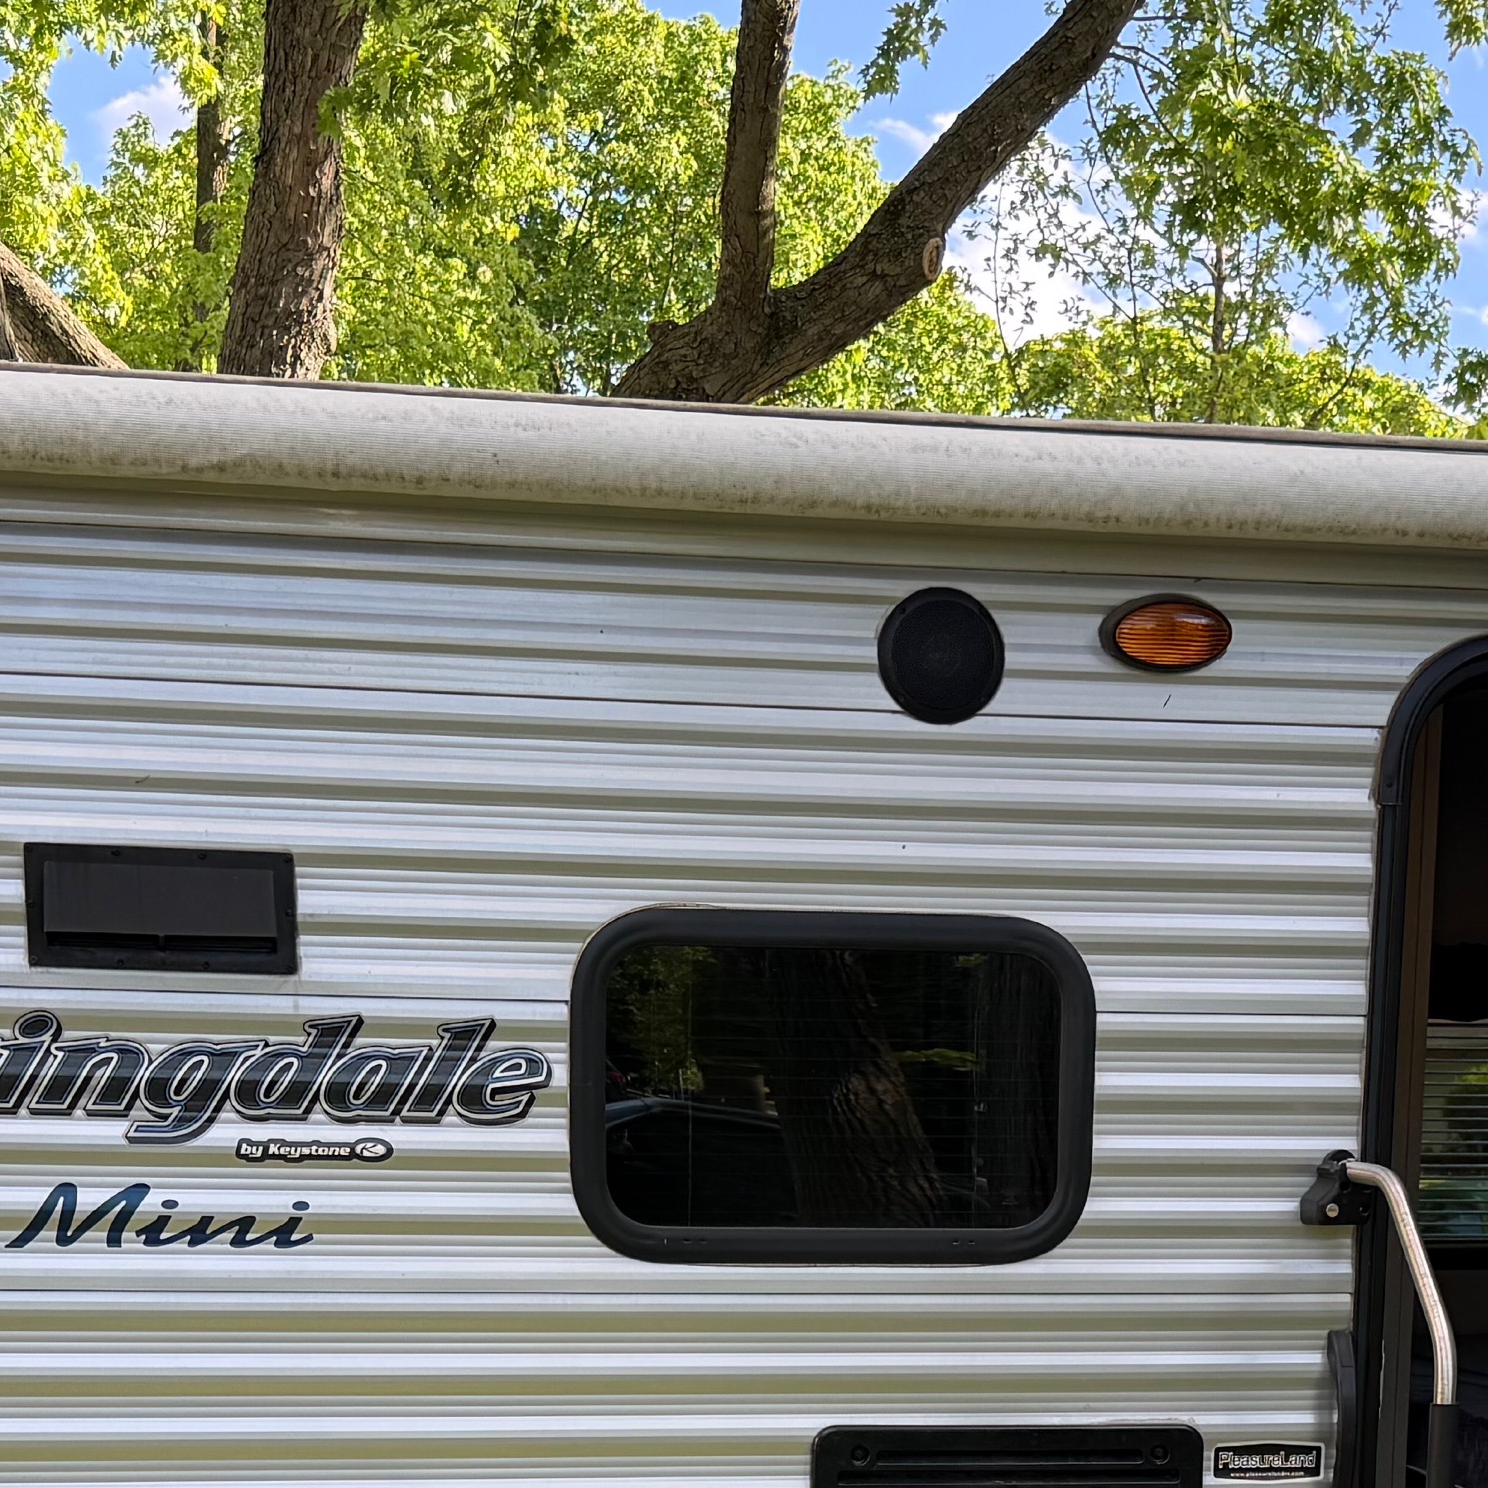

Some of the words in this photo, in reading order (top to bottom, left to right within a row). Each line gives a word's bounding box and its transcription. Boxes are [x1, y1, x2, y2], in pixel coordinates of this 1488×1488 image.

[240, 1142, 264, 1158] by
[268, 1142, 351, 1158] Keystone
[6, 1181, 314, 1249] Mini
[1218, 1450, 1317, 1469] PleasureLand
